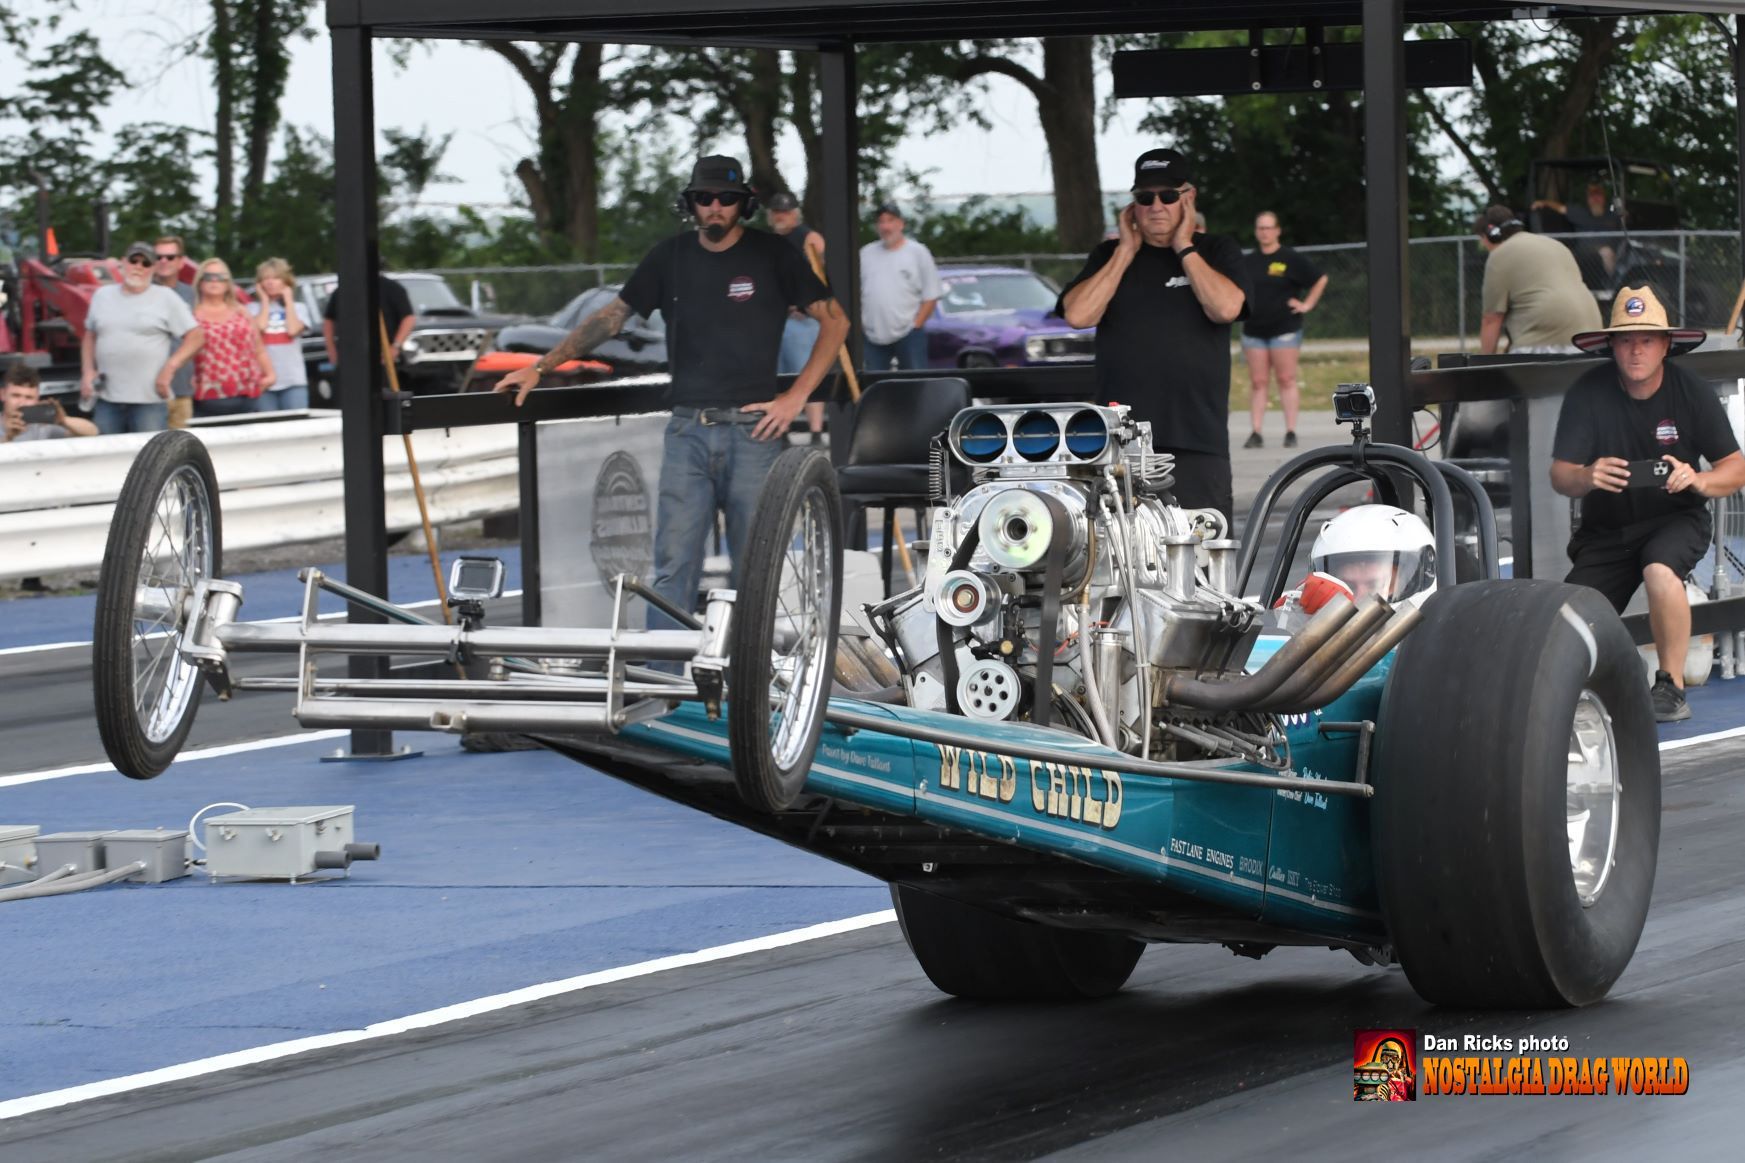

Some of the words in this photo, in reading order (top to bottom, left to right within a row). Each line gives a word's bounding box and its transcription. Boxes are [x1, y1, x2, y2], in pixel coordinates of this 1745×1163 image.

[936, 743, 1017, 802] WILD
[1029, 759, 1123, 830] CHILD
[1205, 848, 1235, 869] ENGINES
[1239, 856, 1264, 877] BRODIX
